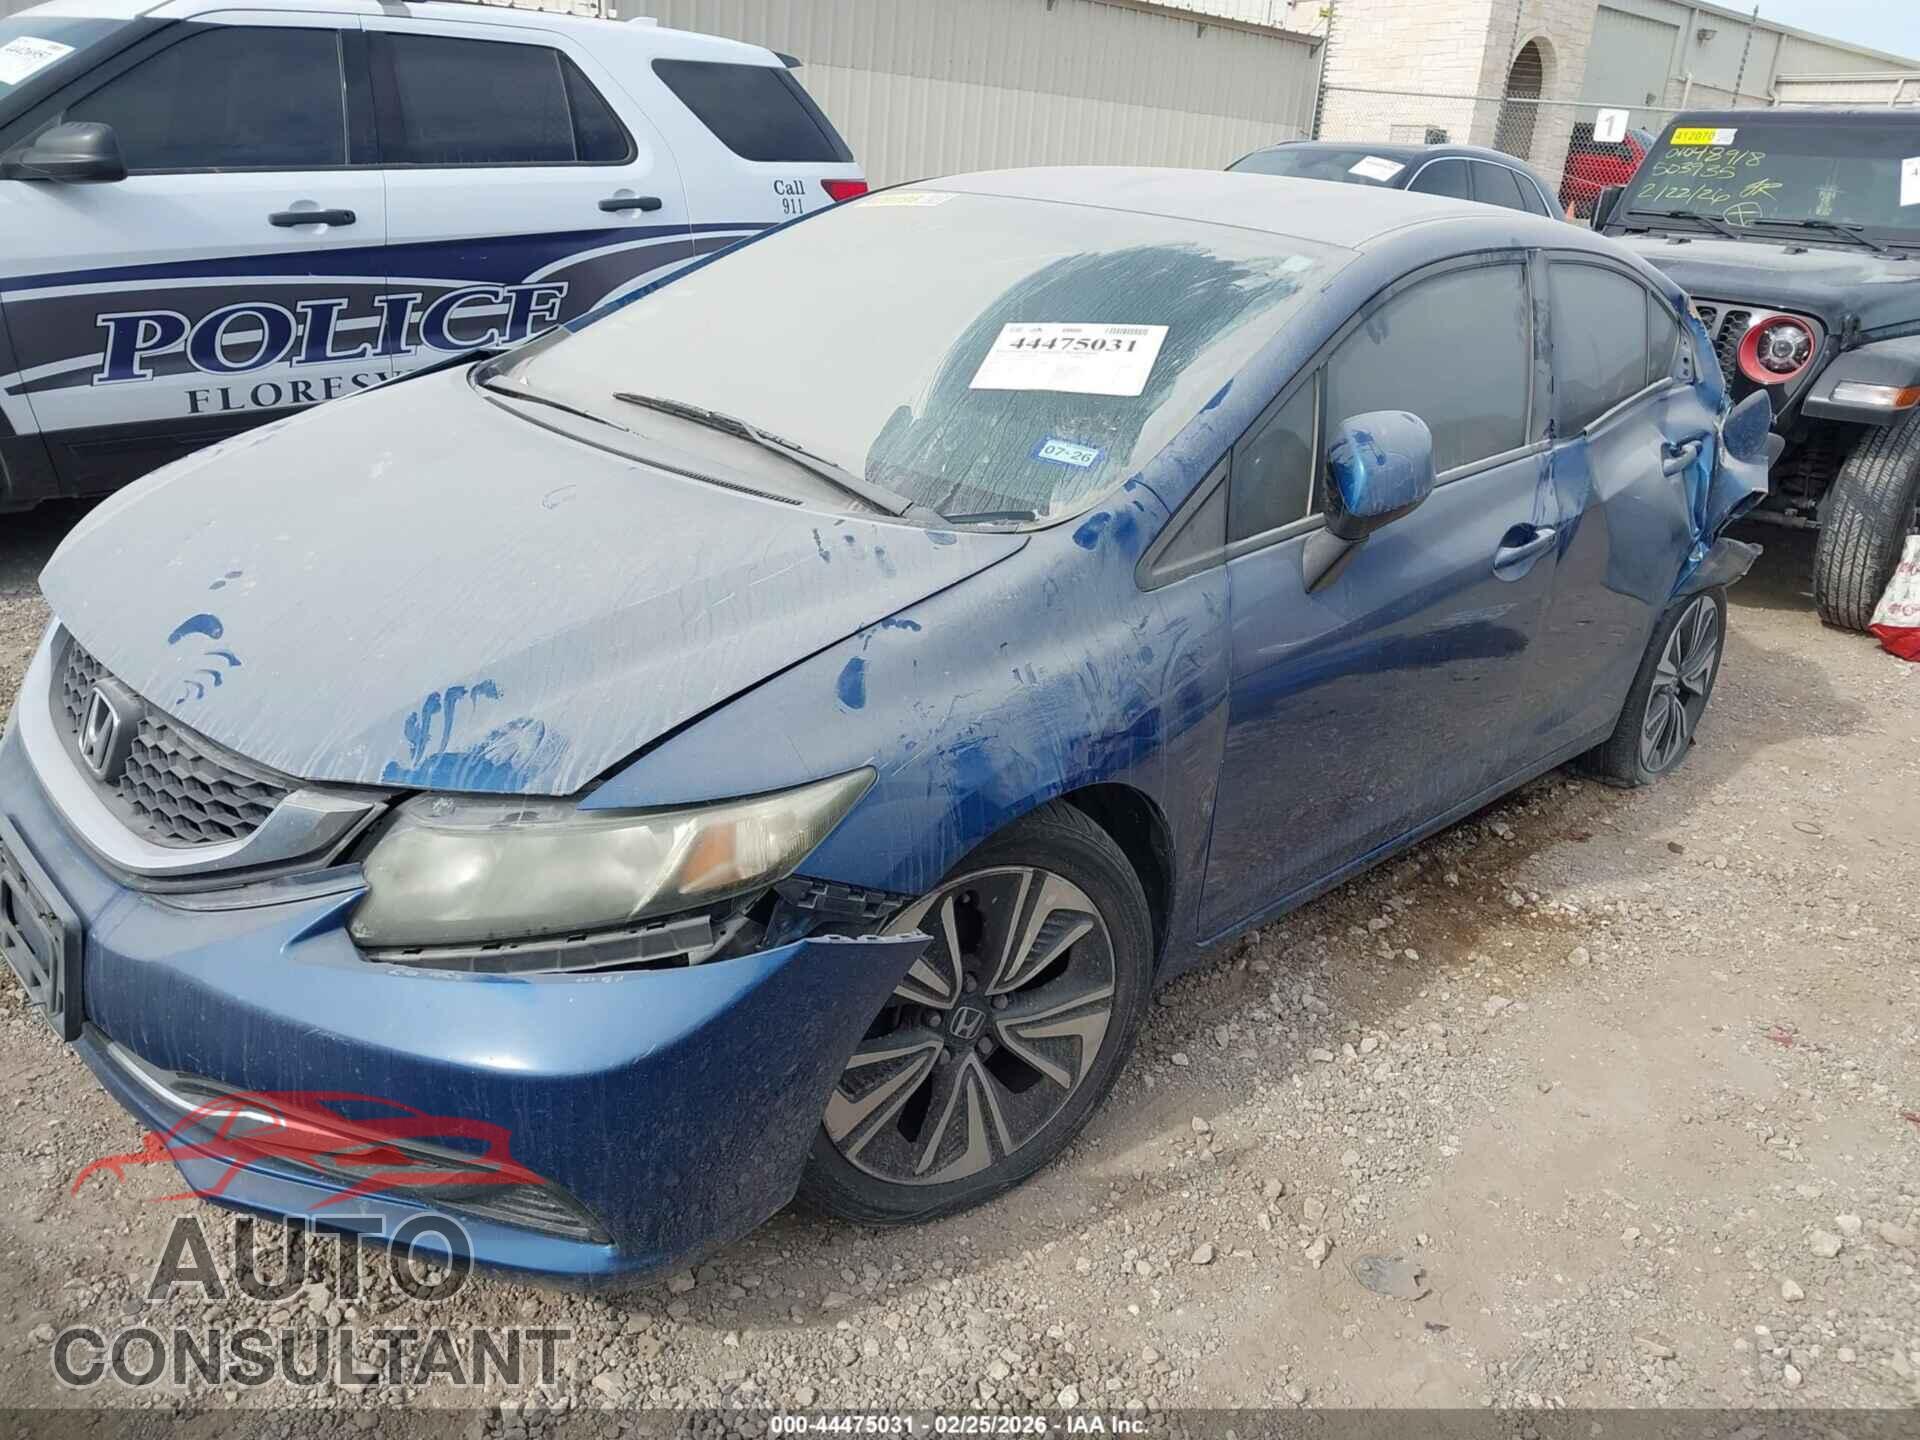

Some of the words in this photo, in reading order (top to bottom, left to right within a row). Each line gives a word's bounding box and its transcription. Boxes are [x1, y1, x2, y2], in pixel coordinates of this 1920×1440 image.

[1604, 115, 1615, 137] 1
[773, 179, 806, 196] Call
[782, 198, 804, 215] 911
[91, 282, 569, 387] POLICE
[1009, 337, 1137, 353] 44475031
